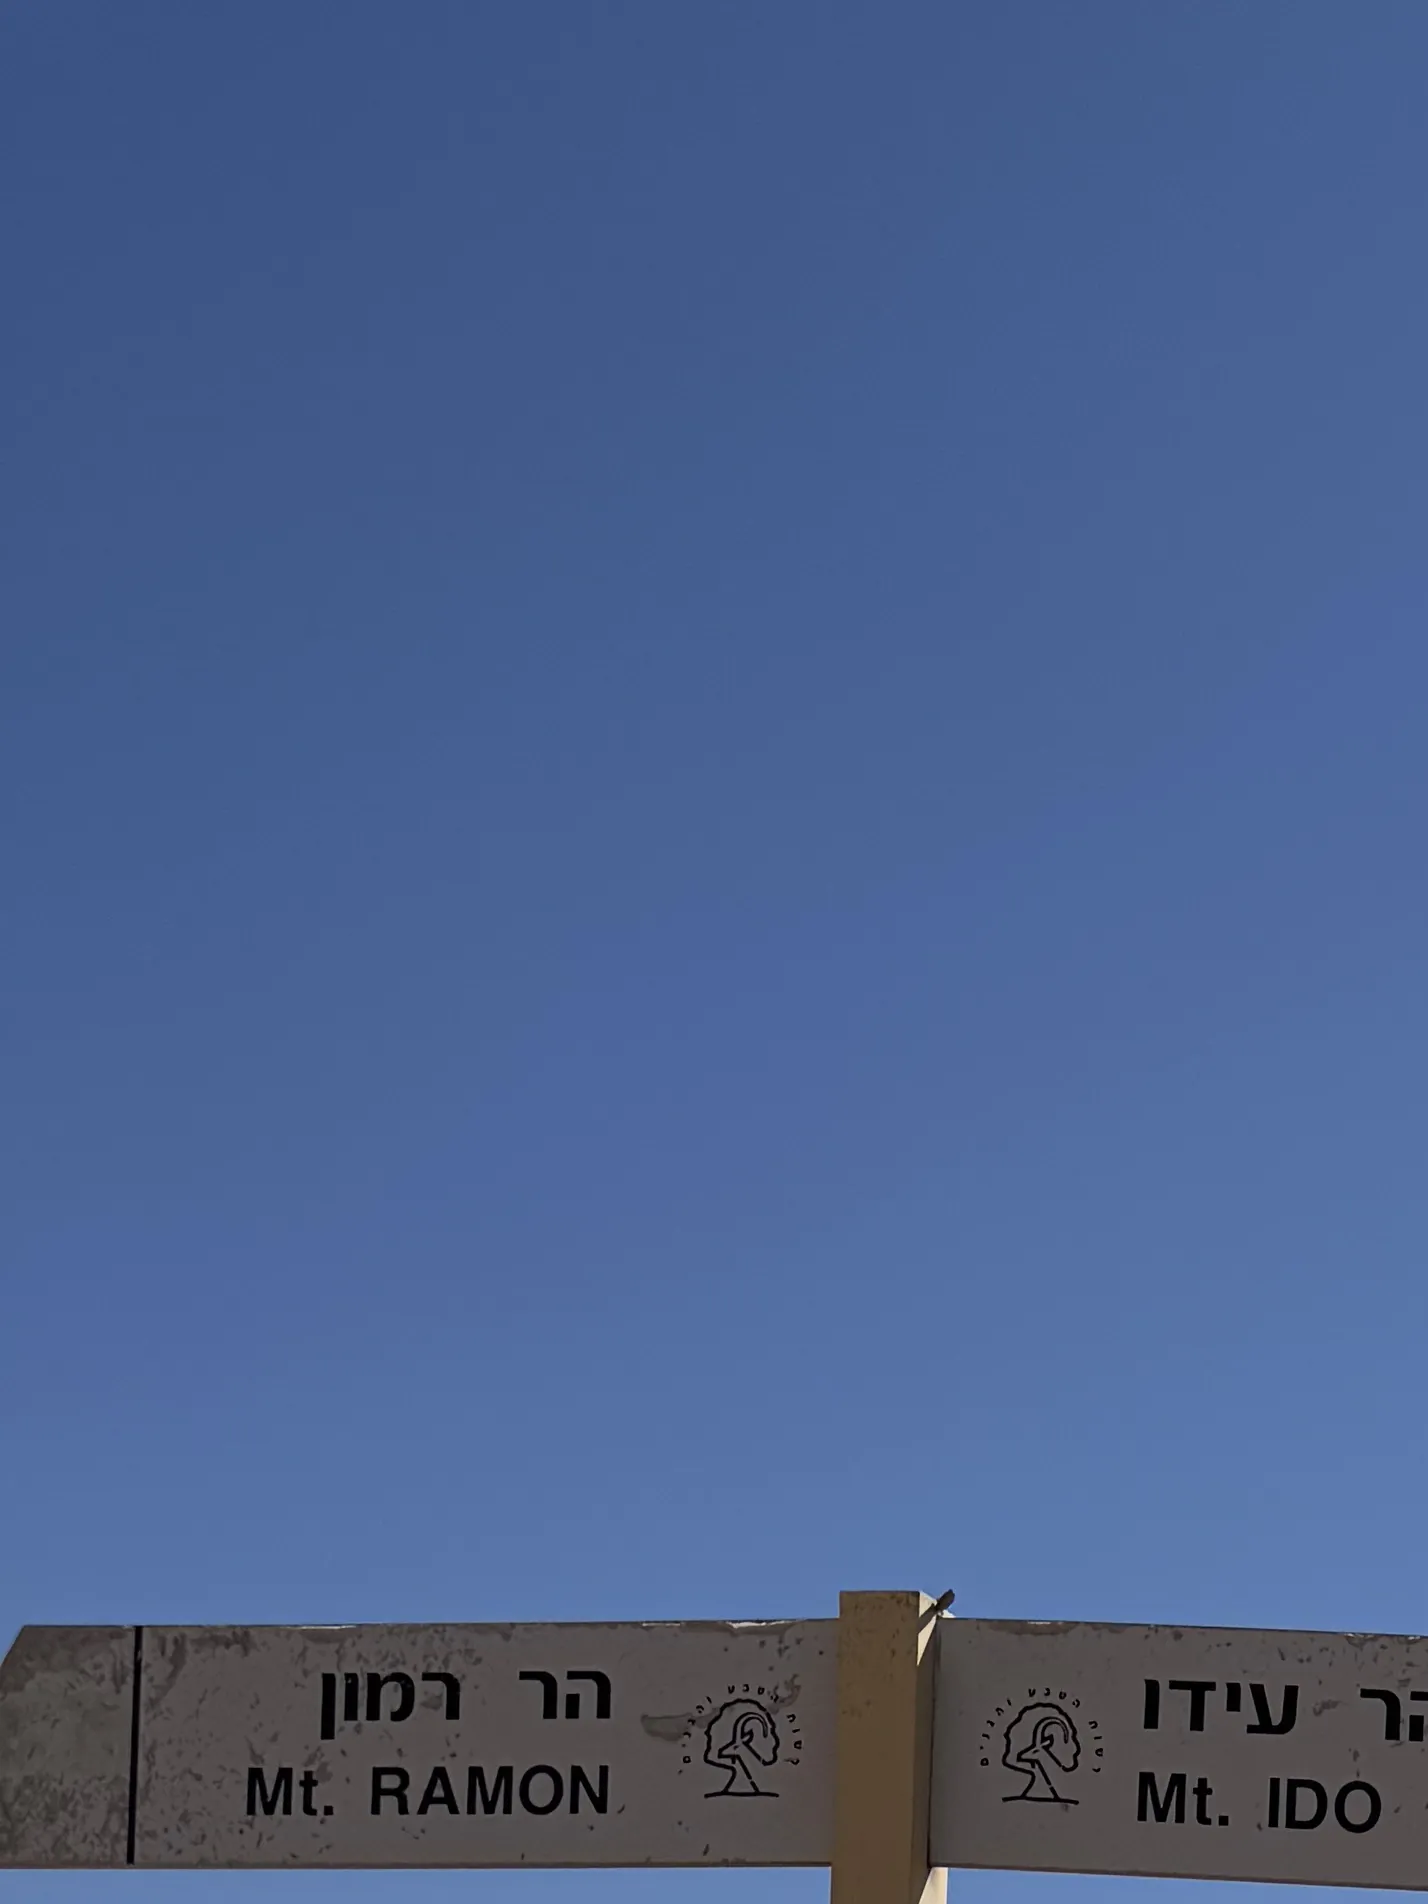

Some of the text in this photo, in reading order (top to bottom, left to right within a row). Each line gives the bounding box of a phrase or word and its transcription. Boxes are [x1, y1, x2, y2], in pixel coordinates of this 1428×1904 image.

[320, 1670, 611, 1741] הר רמון
[1143, 1678, 1299, 1735] עידו
[246, 1764, 609, 1817] Mt. RAMON
[1136, 1771, 1382, 1834] Mt. IDO
